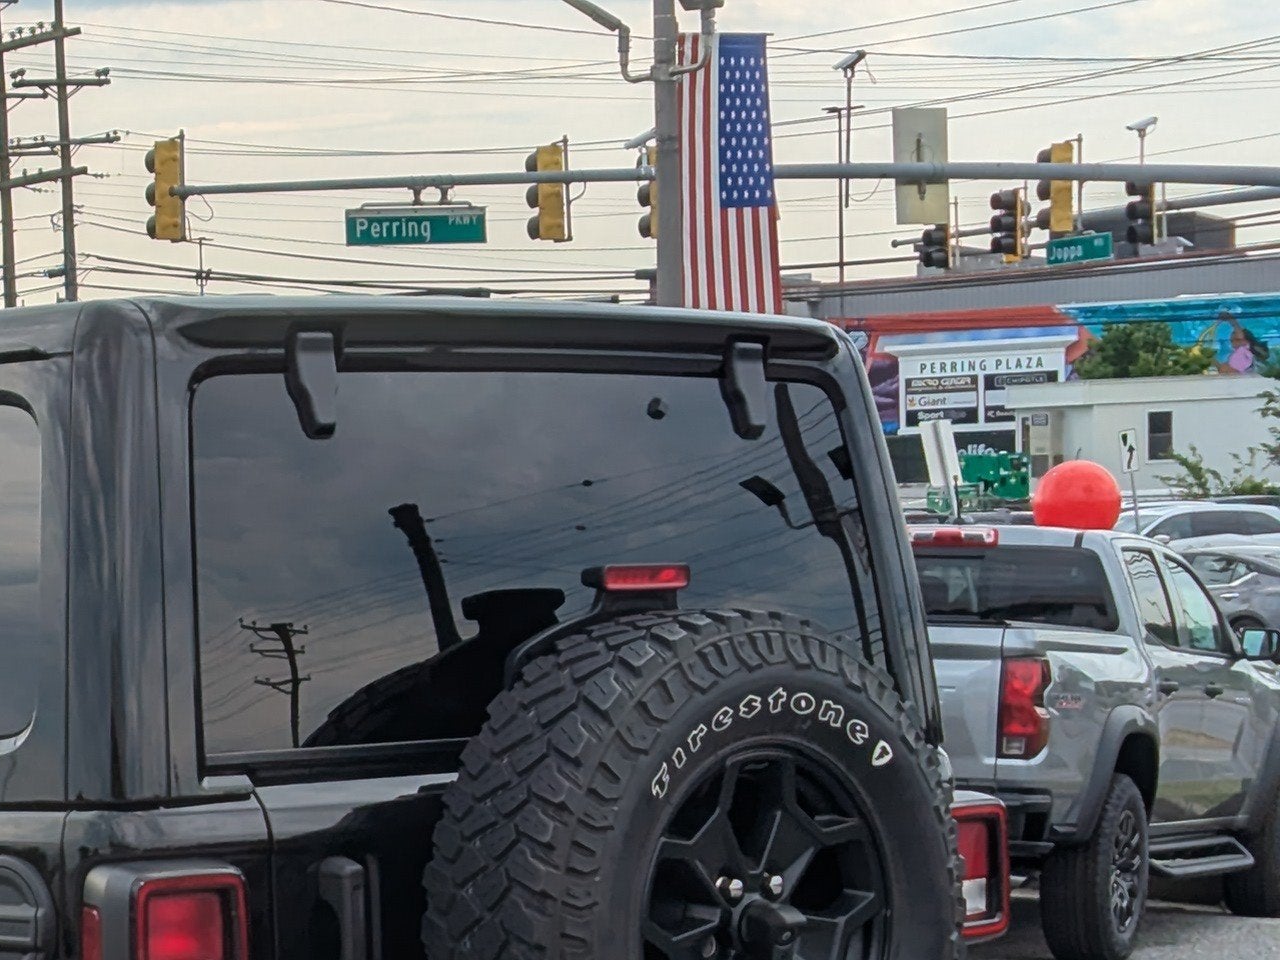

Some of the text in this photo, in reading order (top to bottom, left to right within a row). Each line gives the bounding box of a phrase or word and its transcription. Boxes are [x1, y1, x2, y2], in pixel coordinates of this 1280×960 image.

[355, 215, 478, 242] Perring PKWY
[920, 356, 1044, 374] PERRING PLAZA
[918, 397, 947, 407] Giant
[651, 686, 869, 799] Firestone
